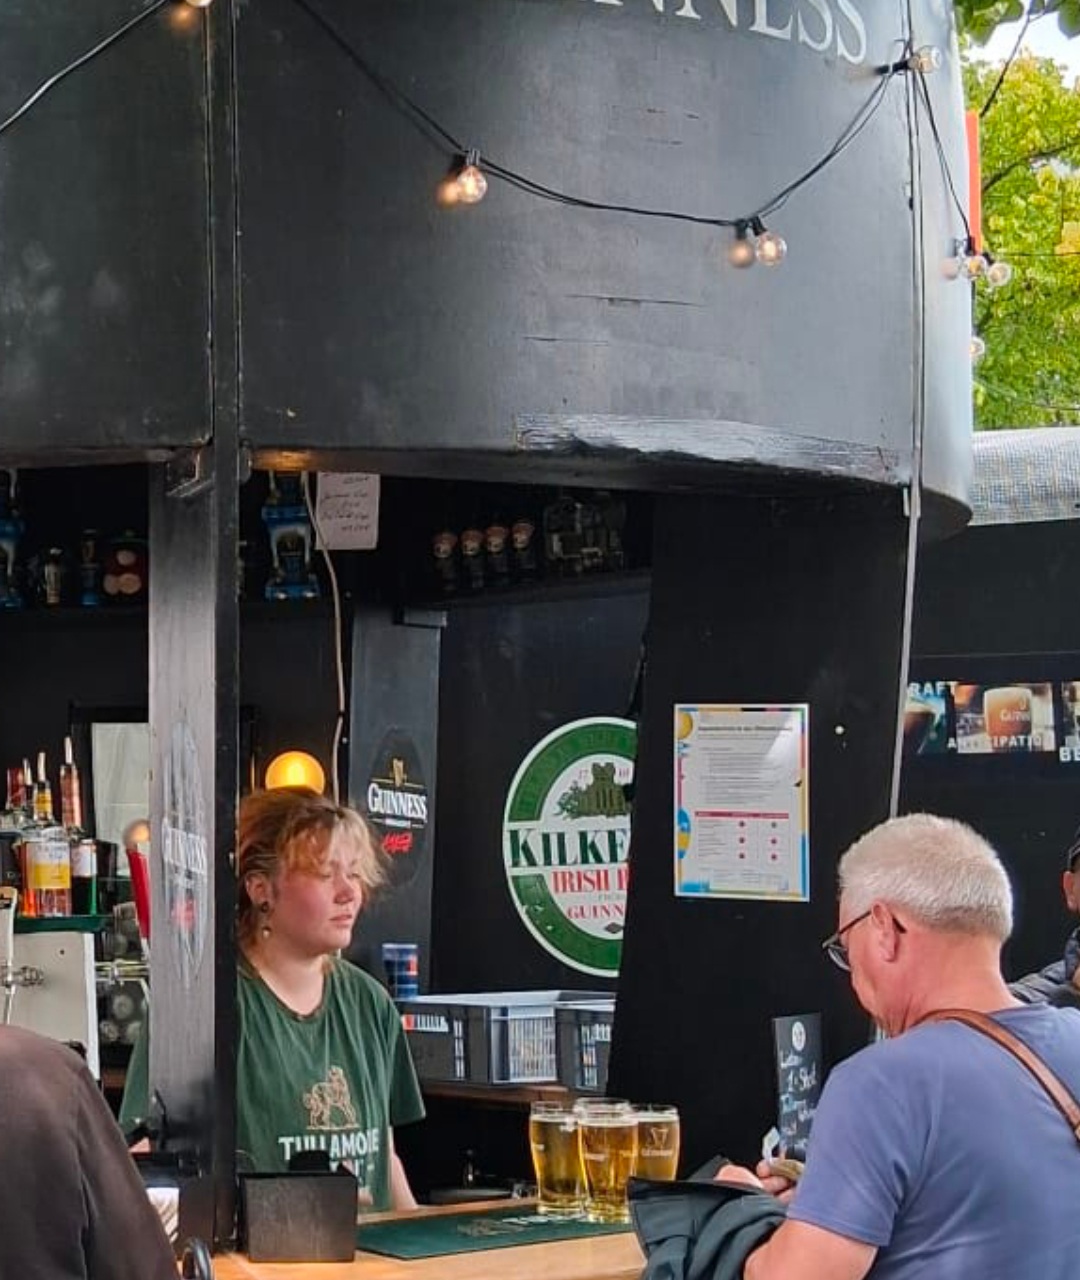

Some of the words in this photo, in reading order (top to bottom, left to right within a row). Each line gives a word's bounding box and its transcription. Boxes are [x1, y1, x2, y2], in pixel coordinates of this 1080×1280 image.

[368, 783, 428, 821] GUINNESS
[509, 828, 628, 868] KILKE
[551, 869, 610, 893] IRISH
[567, 904, 625, 919] GUINN
